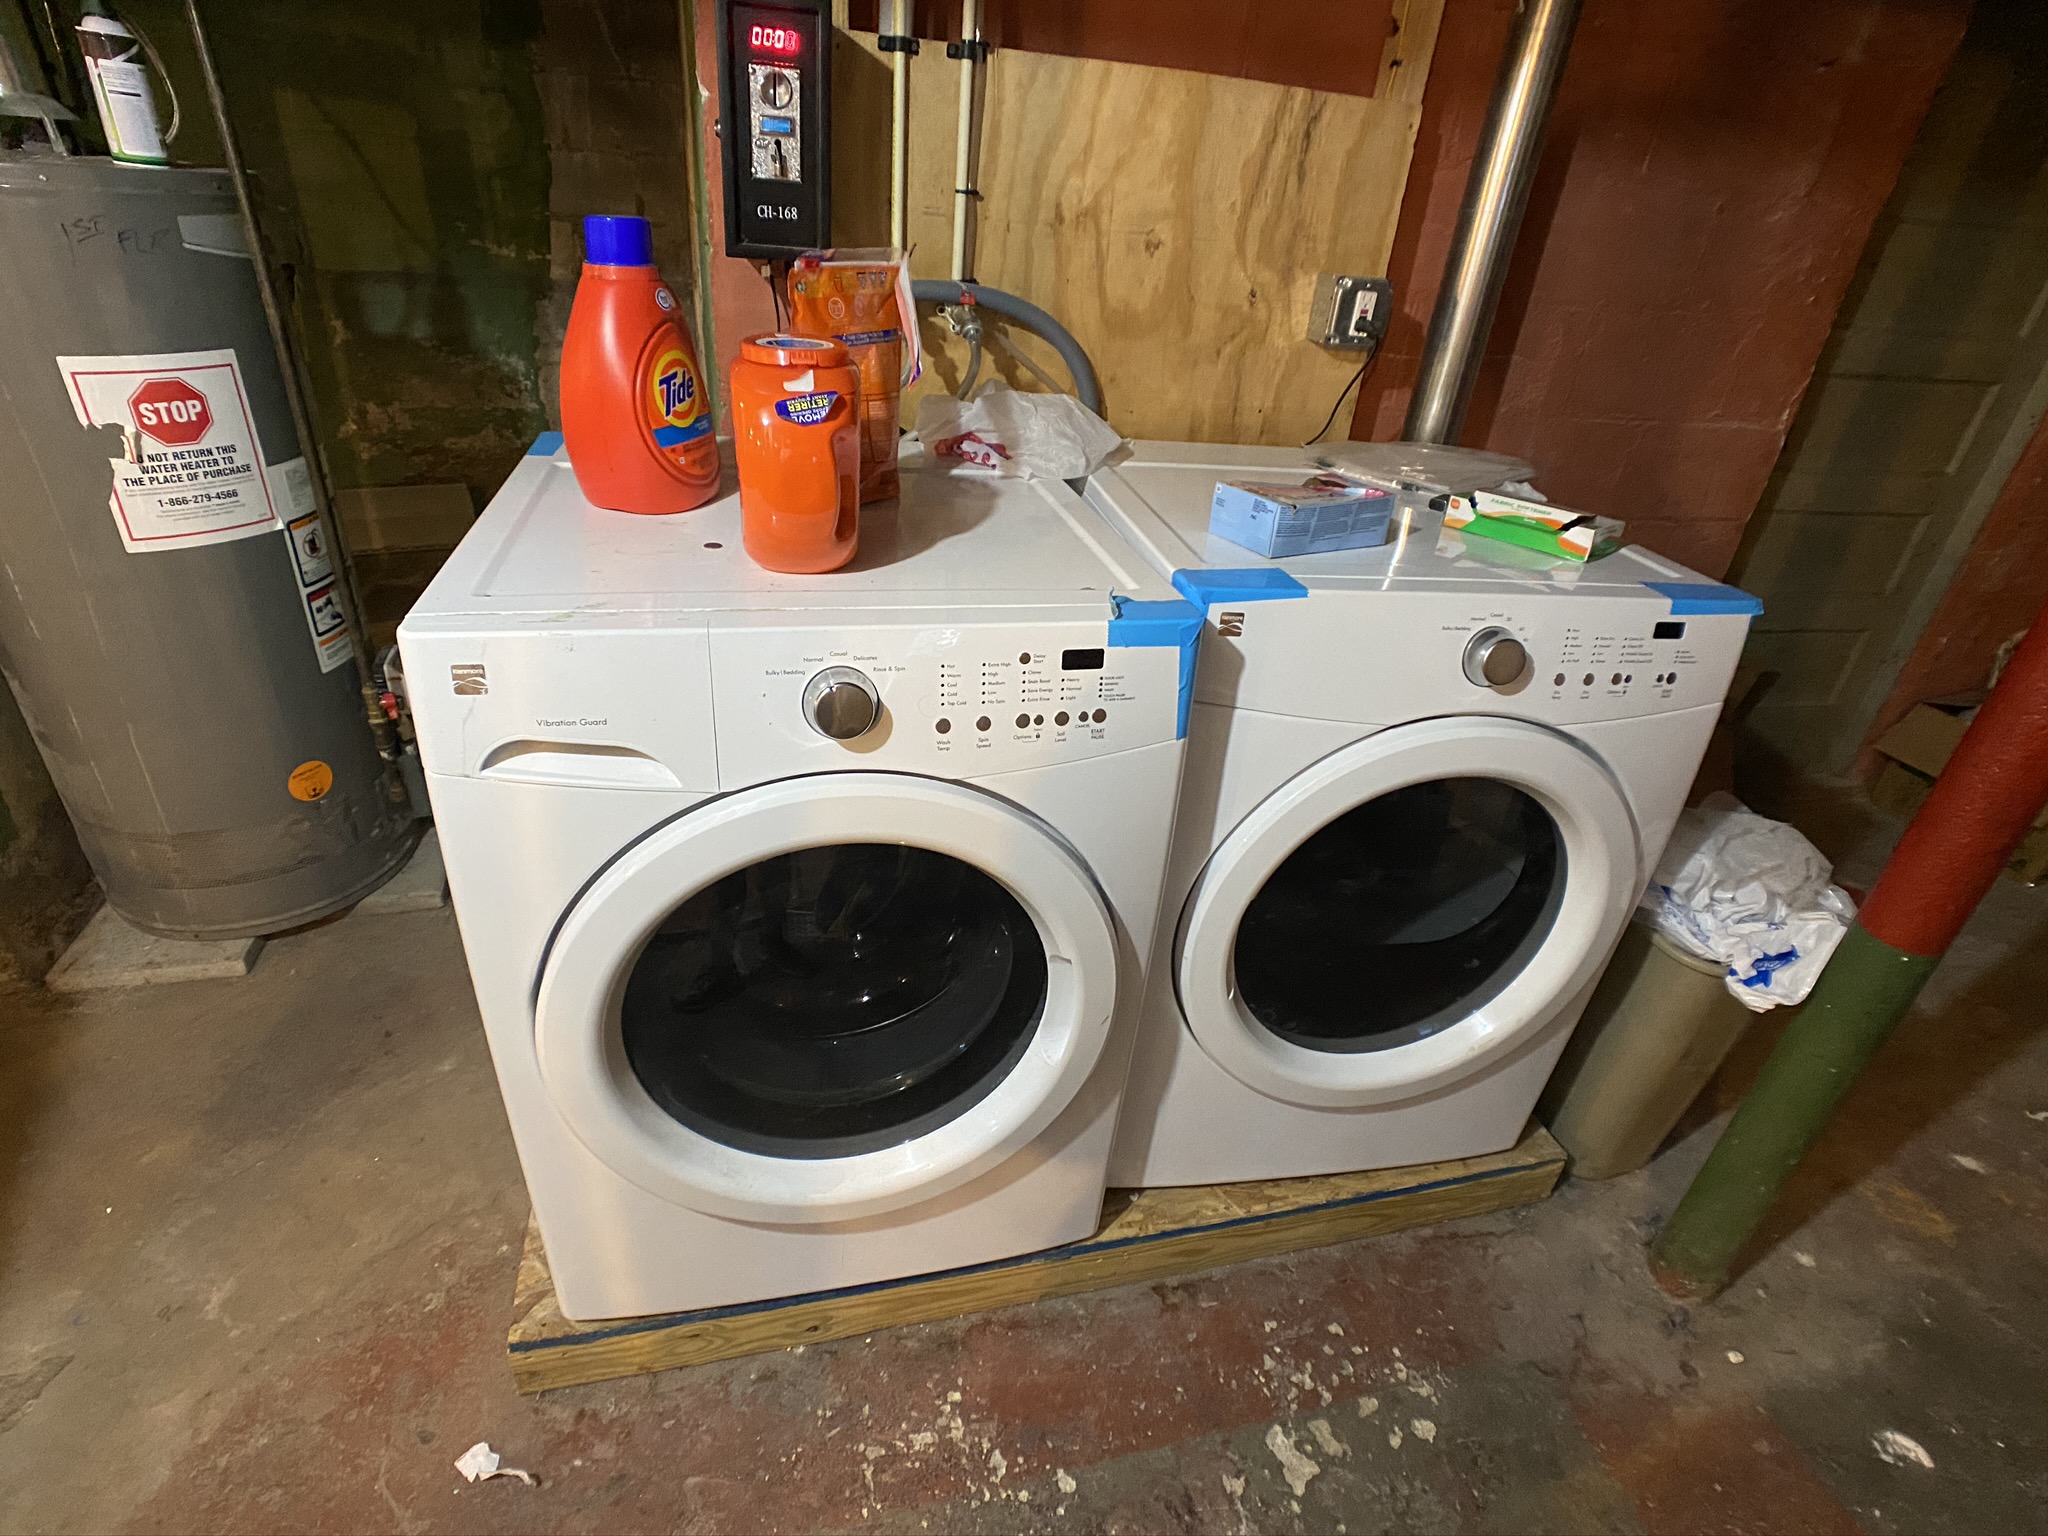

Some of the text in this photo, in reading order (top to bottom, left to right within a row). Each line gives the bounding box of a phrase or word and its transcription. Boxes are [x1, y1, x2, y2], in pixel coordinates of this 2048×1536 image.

[757, 204, 798, 219] CH-168
[657, 368, 695, 420] Tide
[138, 400, 202, 425] STOP
[787, 397, 829, 412] RETIRER
[147, 452, 169, 463] NOT
[172, 447, 214, 461] RETURN
[215, 444, 237, 456] THIS
[139, 456, 235, 475] WATER HEATER TO
[122, 478, 146, 487] THE
[149, 474, 184, 486] PLACE
[186, 471, 200, 482] OF
[203, 464, 252, 480] PURCHASE
[157, 488, 239, 508] 1-866-279-4566
[1490, 498, 1515, 508] FABRIC
[535, 717, 608, 727] Vibration Guard
